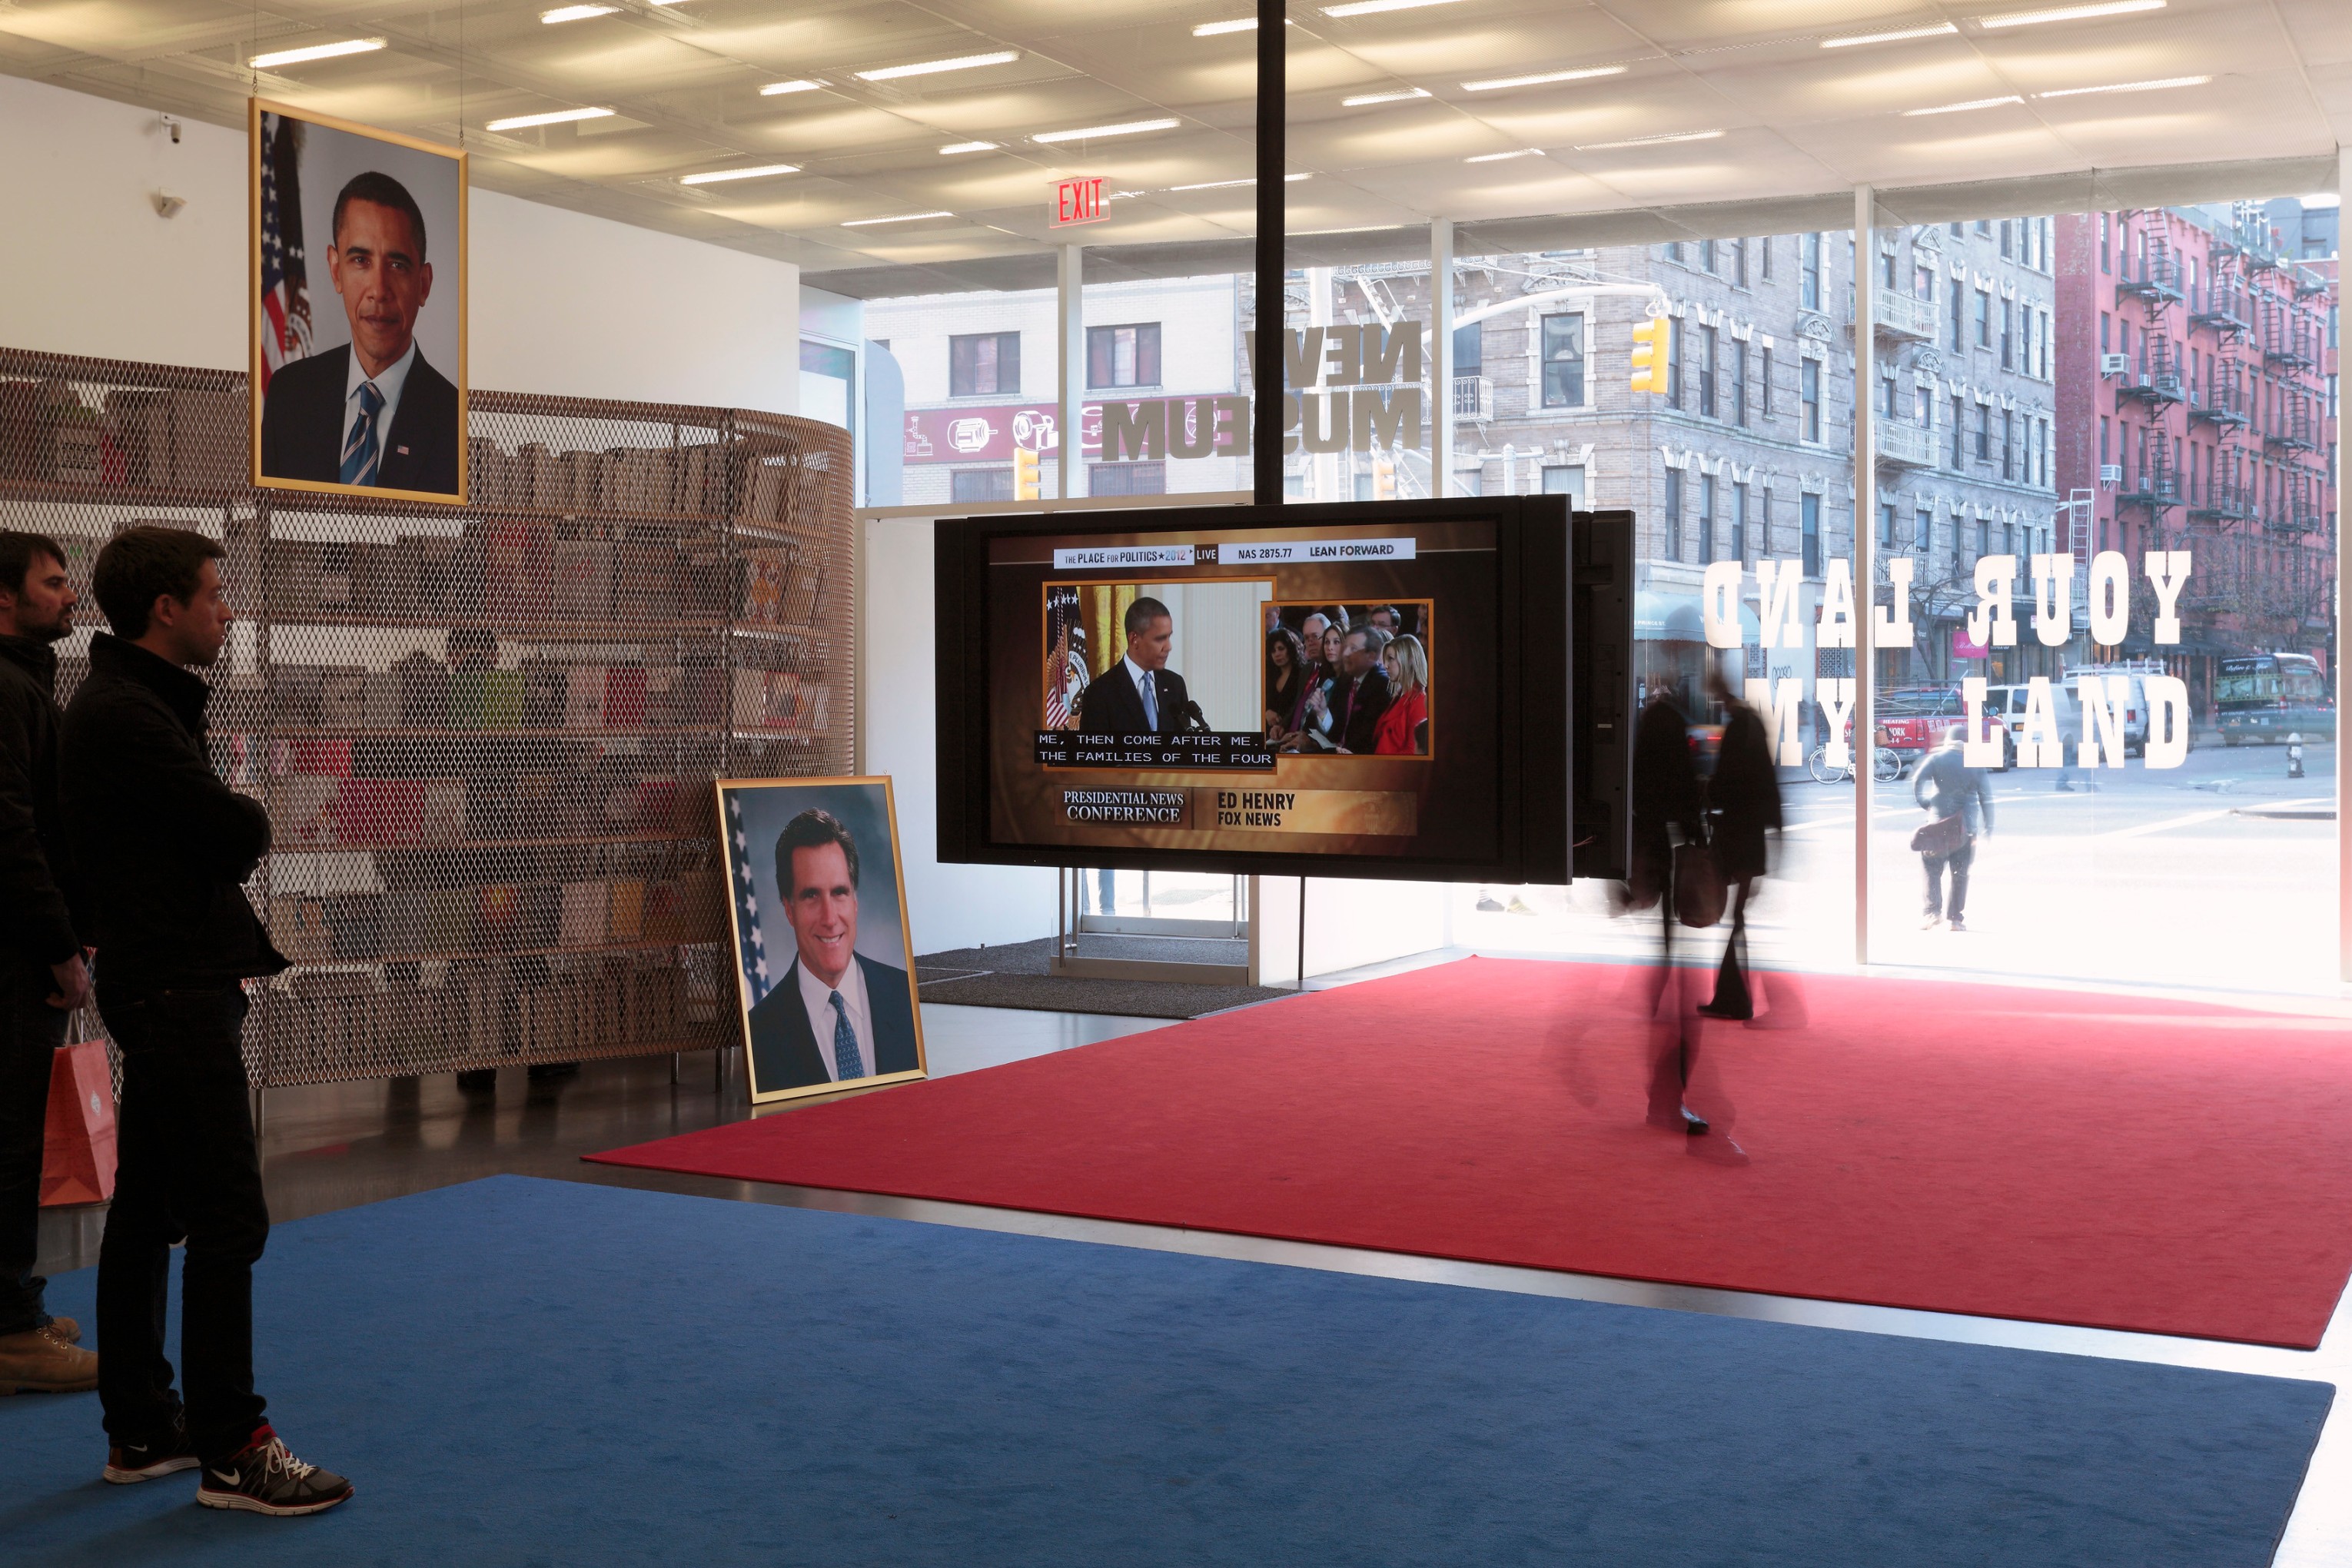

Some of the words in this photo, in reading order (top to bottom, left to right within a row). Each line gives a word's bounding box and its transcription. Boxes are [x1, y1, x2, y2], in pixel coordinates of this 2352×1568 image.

[1059, 178, 1103, 222] EXIT
[1065, 556, 1076, 564] THE
[1078, 553, 1105, 563] PLACE
[1107, 554, 1119, 563] FOR
[1120, 551, 1158, 563] POLITICS
[1165, 550, 1186, 561] 2012
[1196, 549, 1217, 560] LIVE
[1238, 550, 1257, 560] NAS
[1259, 548, 1292, 559] 2875.77
[1310, 546, 1337, 556] LEAN
[1340, 544, 1394, 556] FORWARD
[1745, 677, 1856, 767] MY
[1962, 676, 2189, 769] LAND
[1039, 735, 1065, 746] ME,
[1077, 735, 1114, 745] THEN
[1124, 736, 1161, 746] COME
[1171, 736, 1221, 746] AFTER
[1231, 736, 1258, 746] ME.
[1040, 751, 1067, 761] THE
[1077, 752, 1152, 762] FAMILIES
[1162, 752, 1181, 762] OF
[1191, 753, 1221, 763] THE
[1231, 753, 1272, 764] FOUR
[1064, 790, 1148, 805] PRESIDENTIAL
[1150, 793, 1184, 806] NEWS
[1218, 792, 1237, 809] ED
[1243, 792, 1295, 810] HENRY
[1066, 806, 1181, 822] CONFERENCE
[1218, 811, 1241, 826] FOX
[1246, 812, 1281, 827] NEWS
